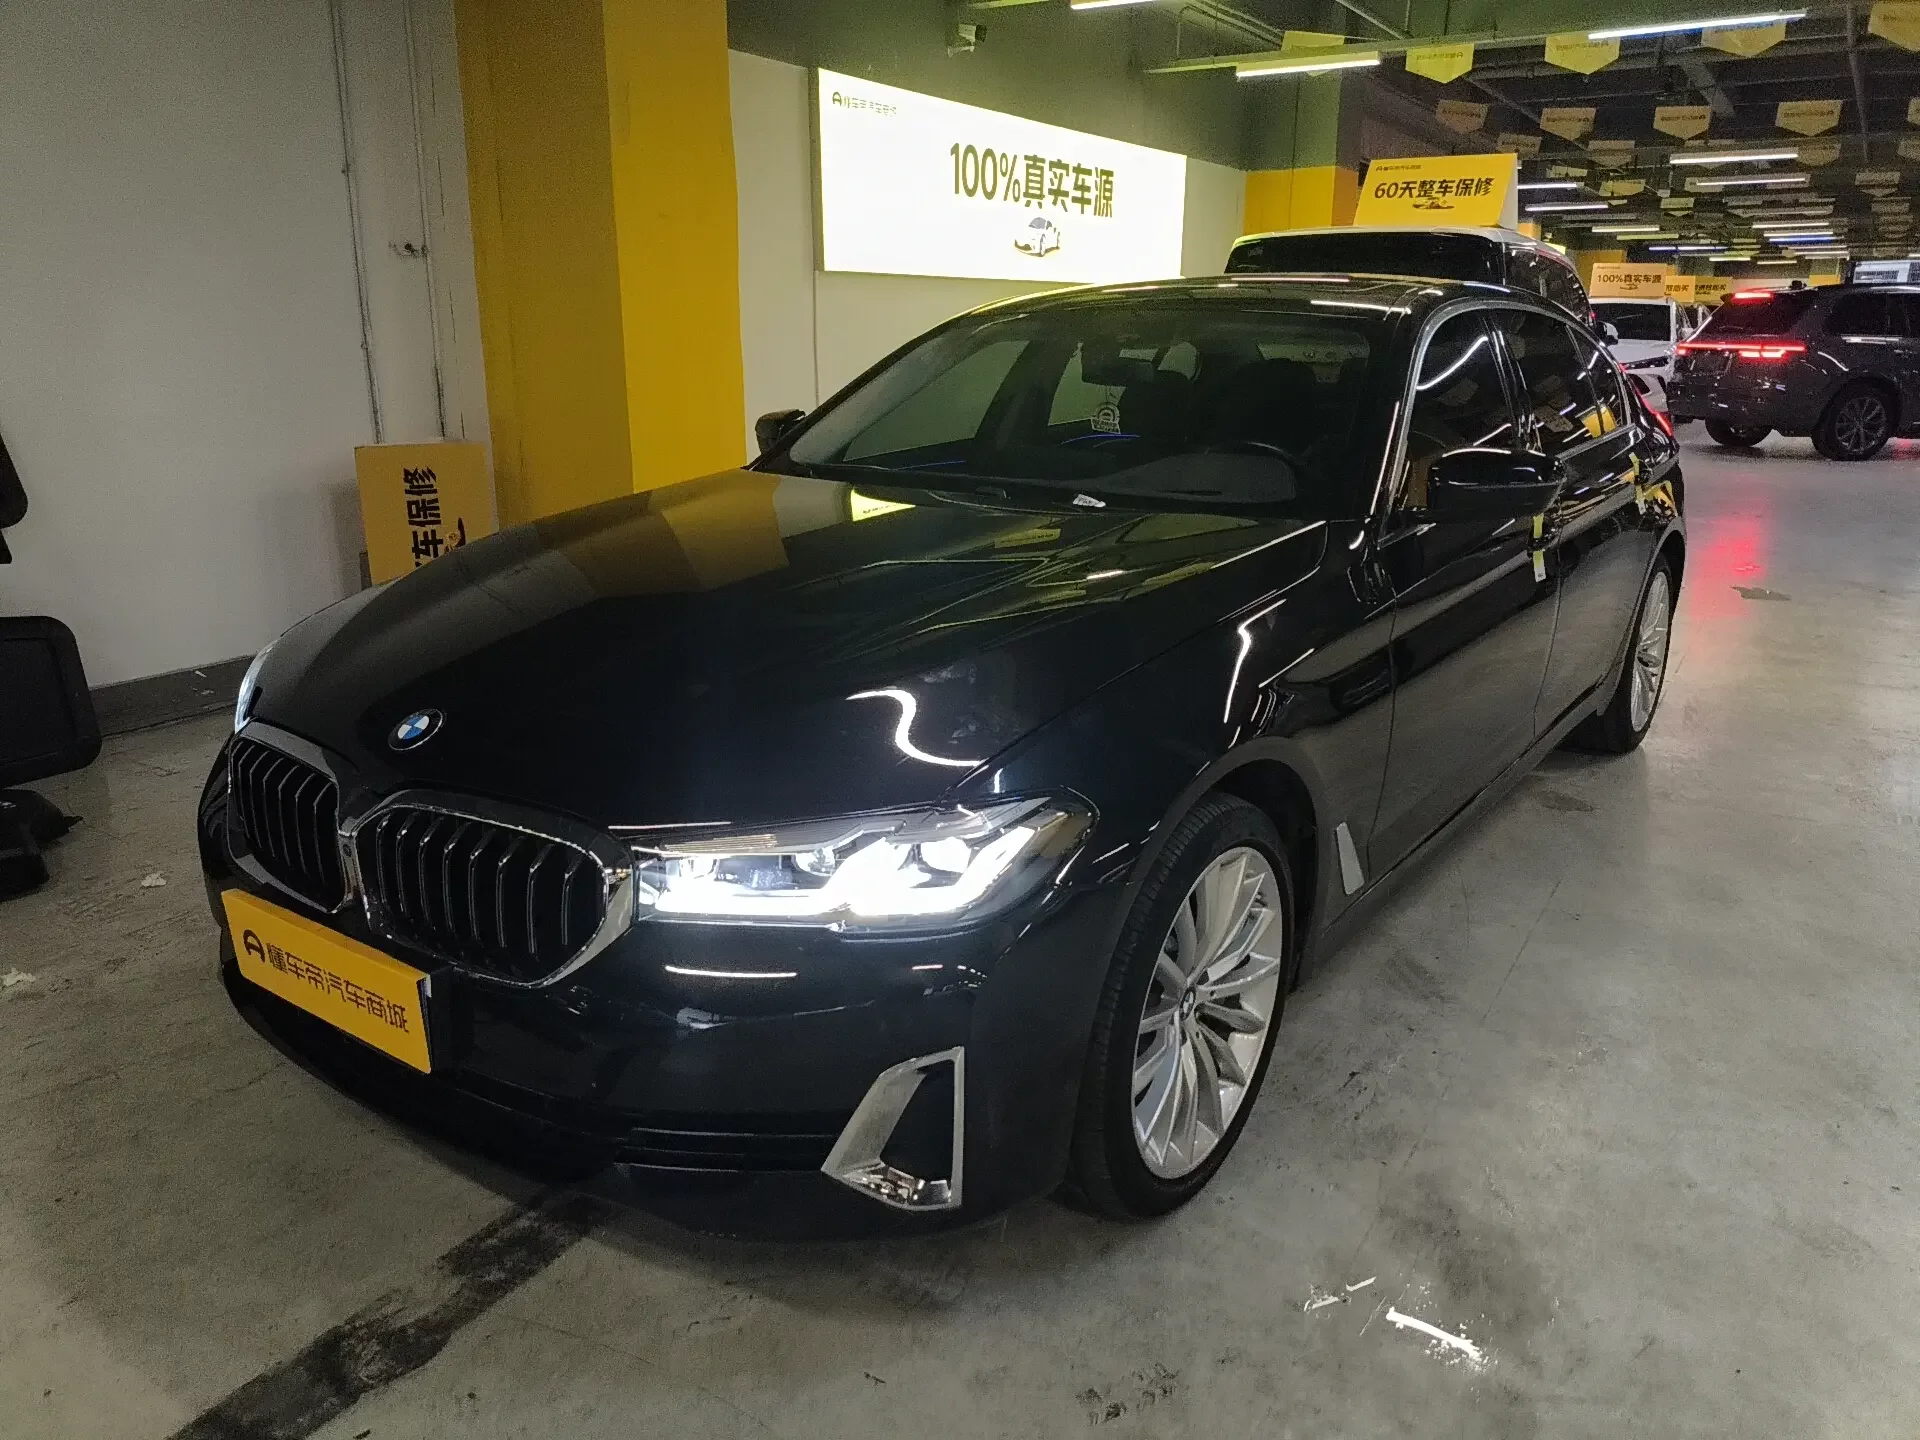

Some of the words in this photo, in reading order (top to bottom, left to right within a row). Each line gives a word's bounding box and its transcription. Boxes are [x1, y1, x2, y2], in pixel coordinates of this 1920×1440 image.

[950, 142, 1115, 218] 100%真实车源
[1374, 177, 1495, 199] 60天整车保修
[1596, 274, 1662, 284] 100%真实车源
[403, 466, 444, 567] 车保修
[266, 942, 410, 1034] 懂车帝汽车商城
